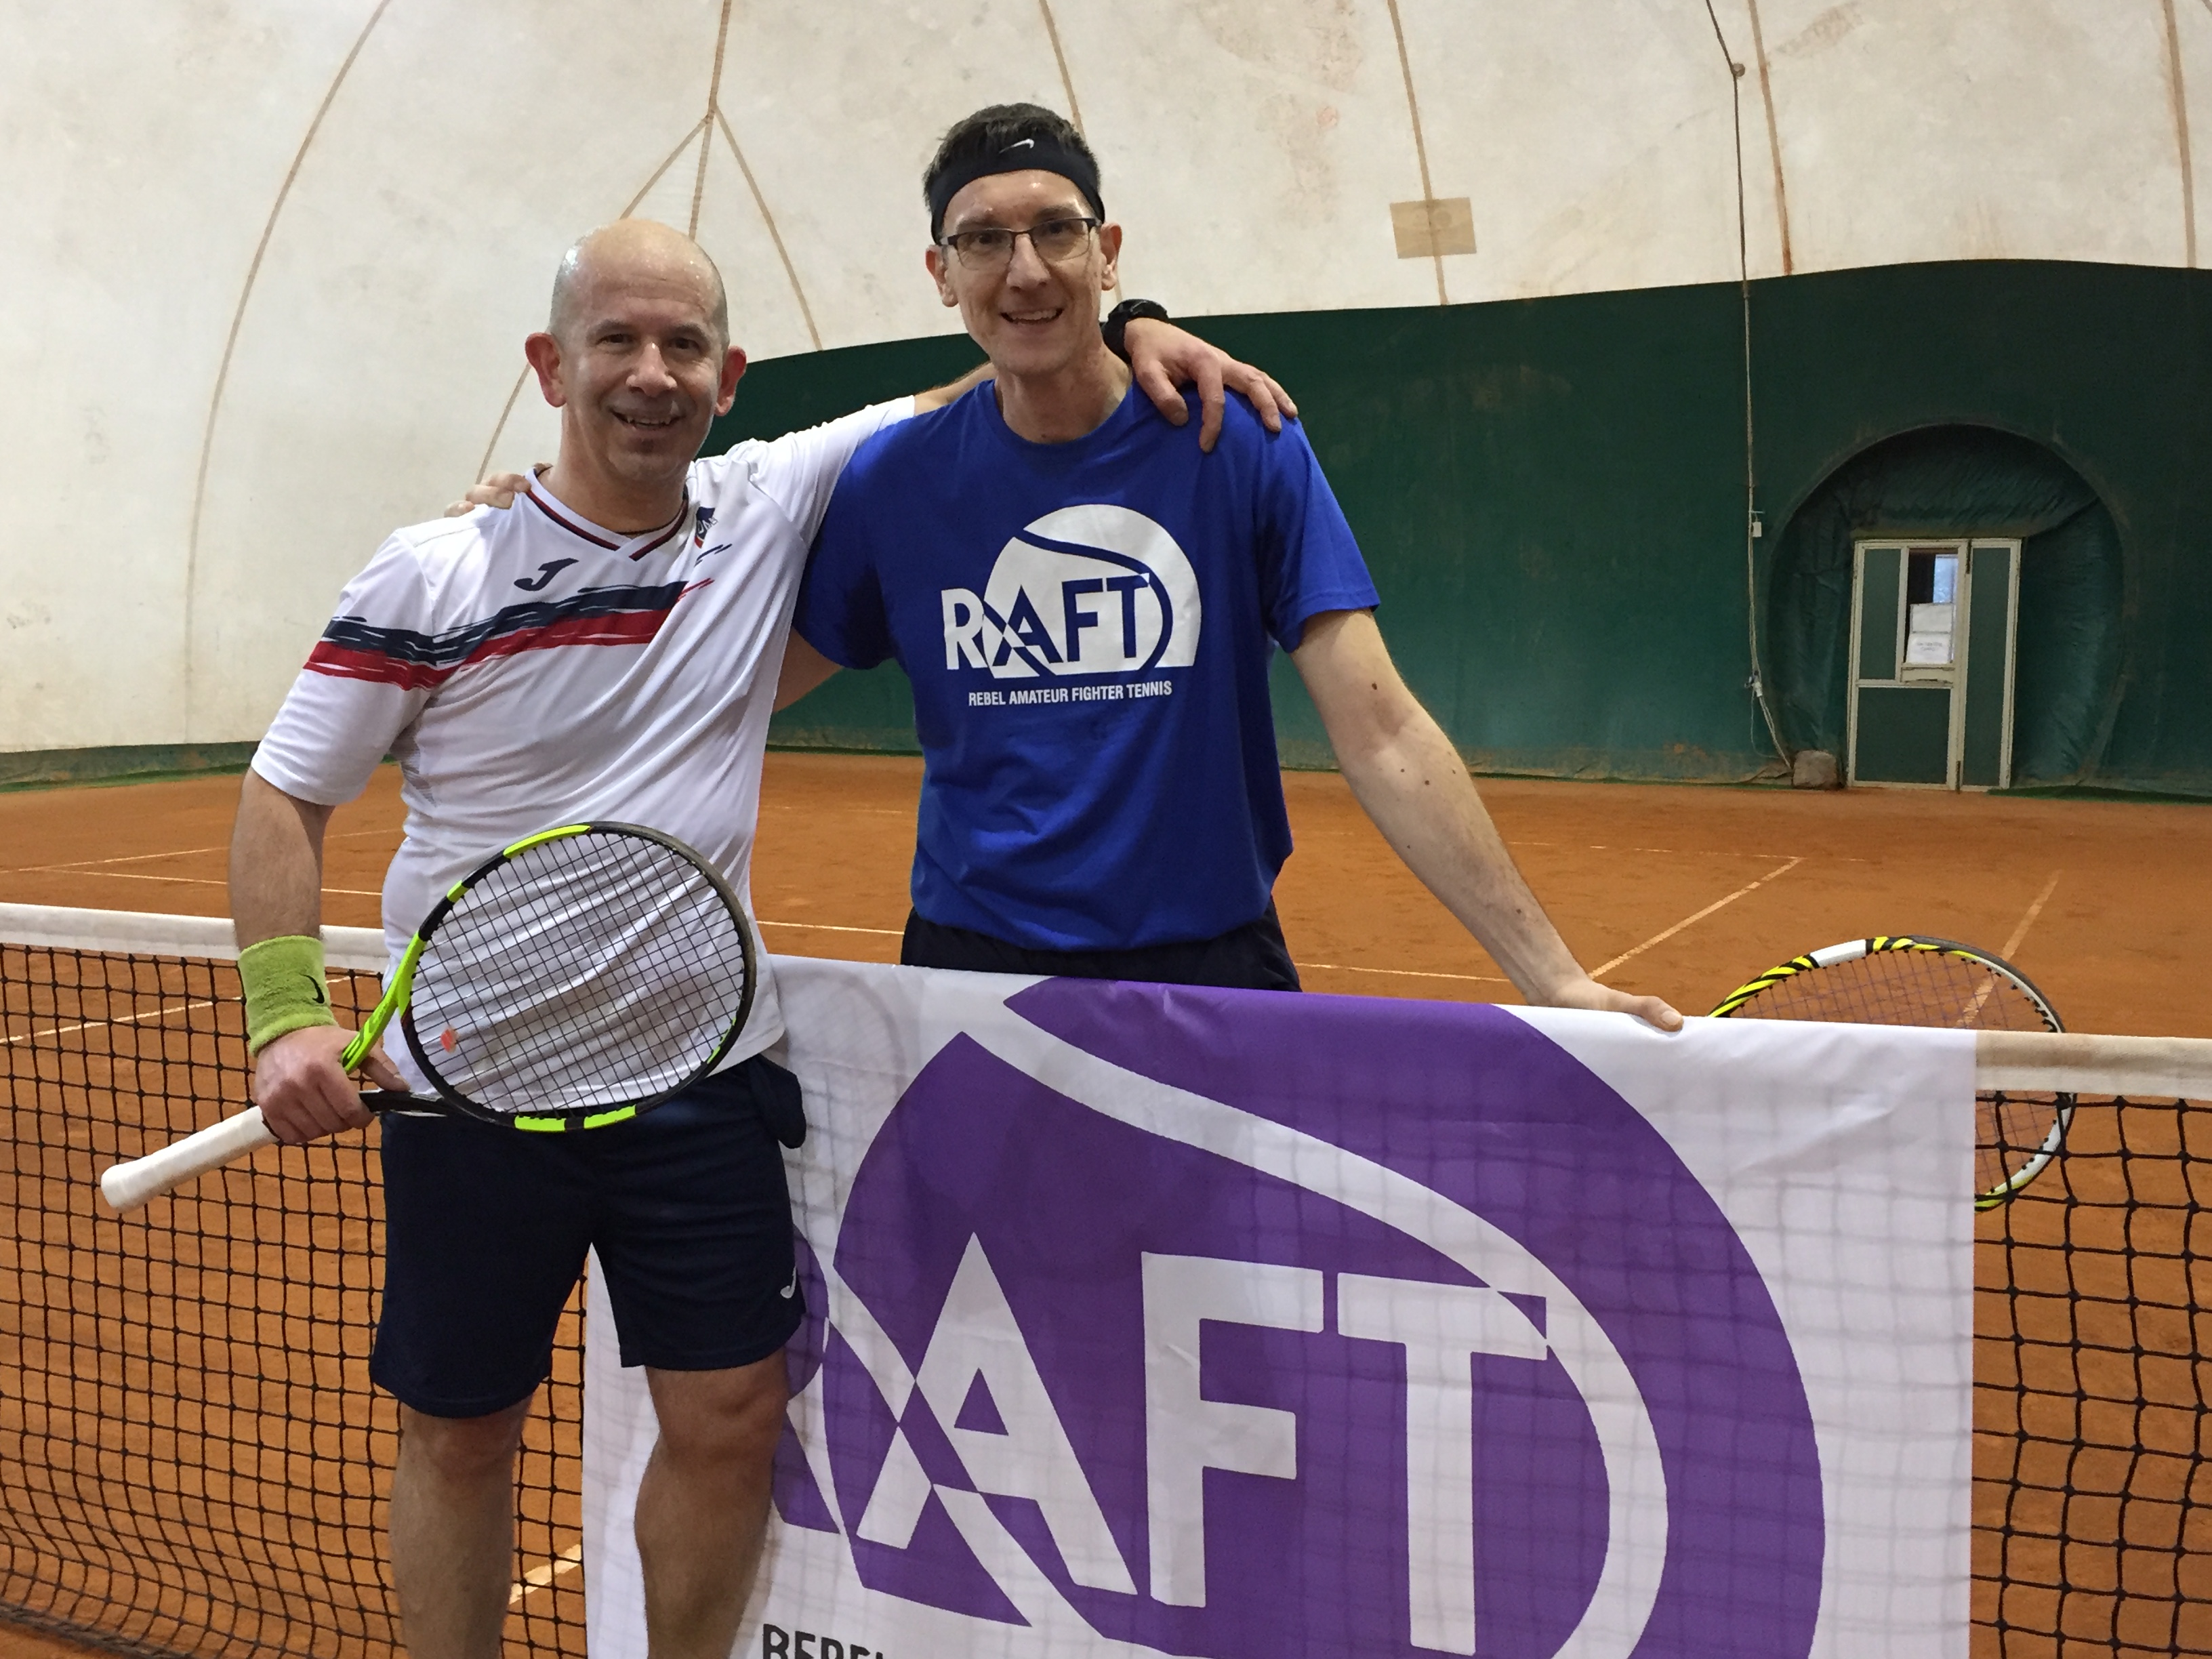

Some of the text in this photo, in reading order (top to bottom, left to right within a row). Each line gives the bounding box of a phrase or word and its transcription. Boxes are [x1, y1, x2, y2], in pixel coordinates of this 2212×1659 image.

[941, 573, 1150, 670] RAFT
[968, 680, 1172, 706] REBEL AMATEUR FIGHTER TENNIS
